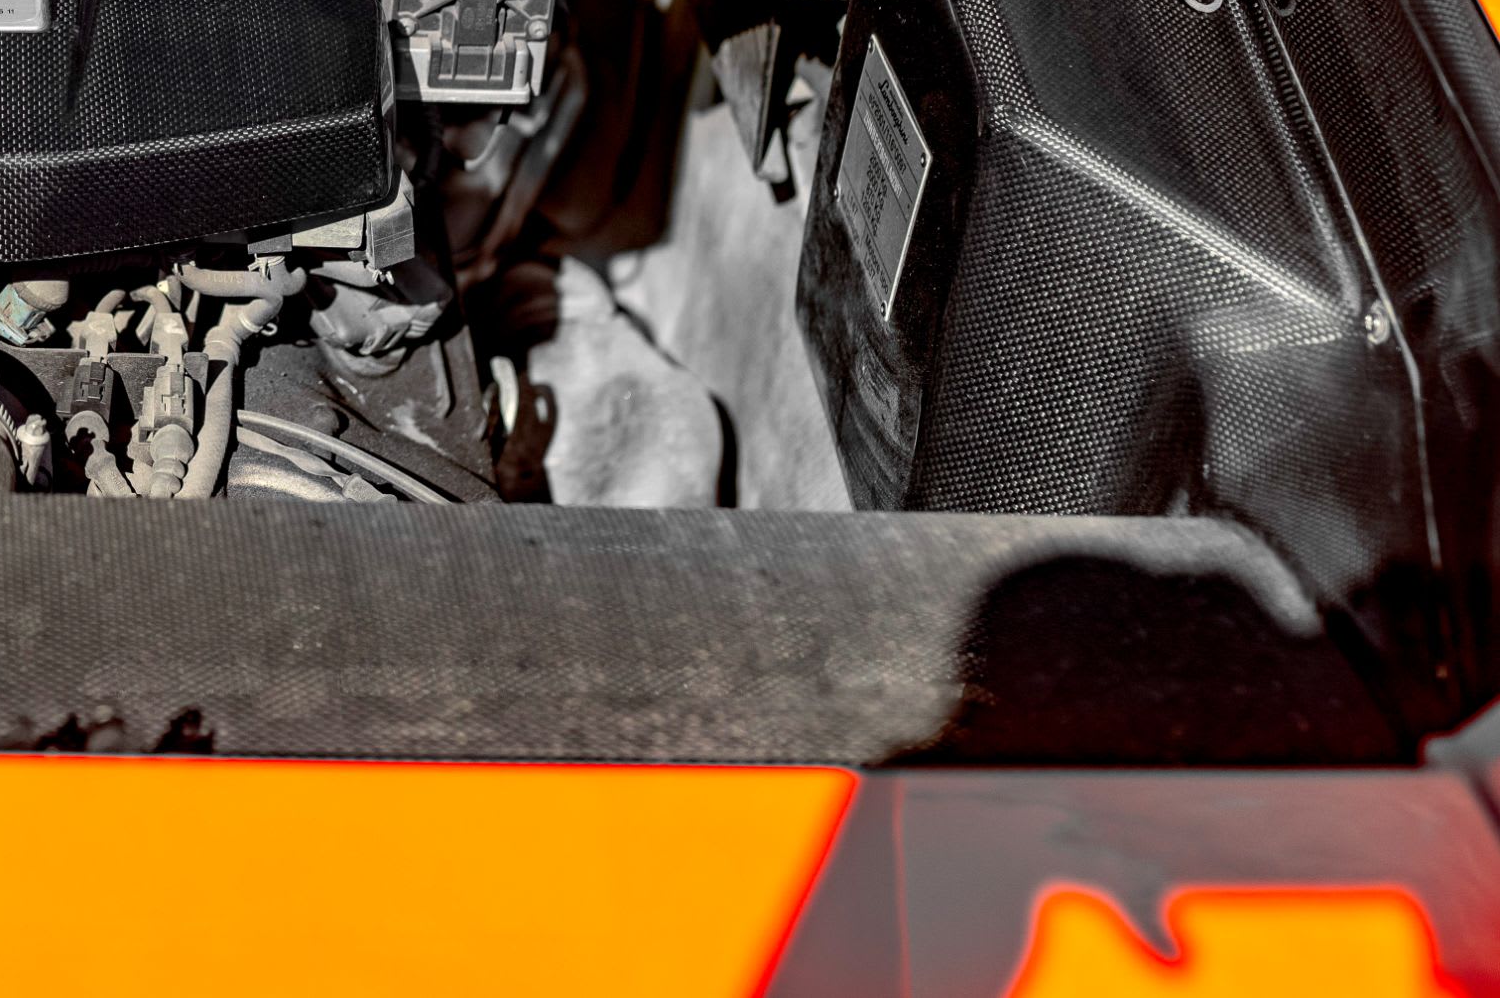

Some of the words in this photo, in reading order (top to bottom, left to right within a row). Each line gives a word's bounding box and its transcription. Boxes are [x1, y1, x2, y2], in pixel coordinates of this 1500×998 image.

[878, 80, 907, 144] Lamborghini
[865, 234, 879, 273] Motore
[879, 270, 888, 294] tipo
